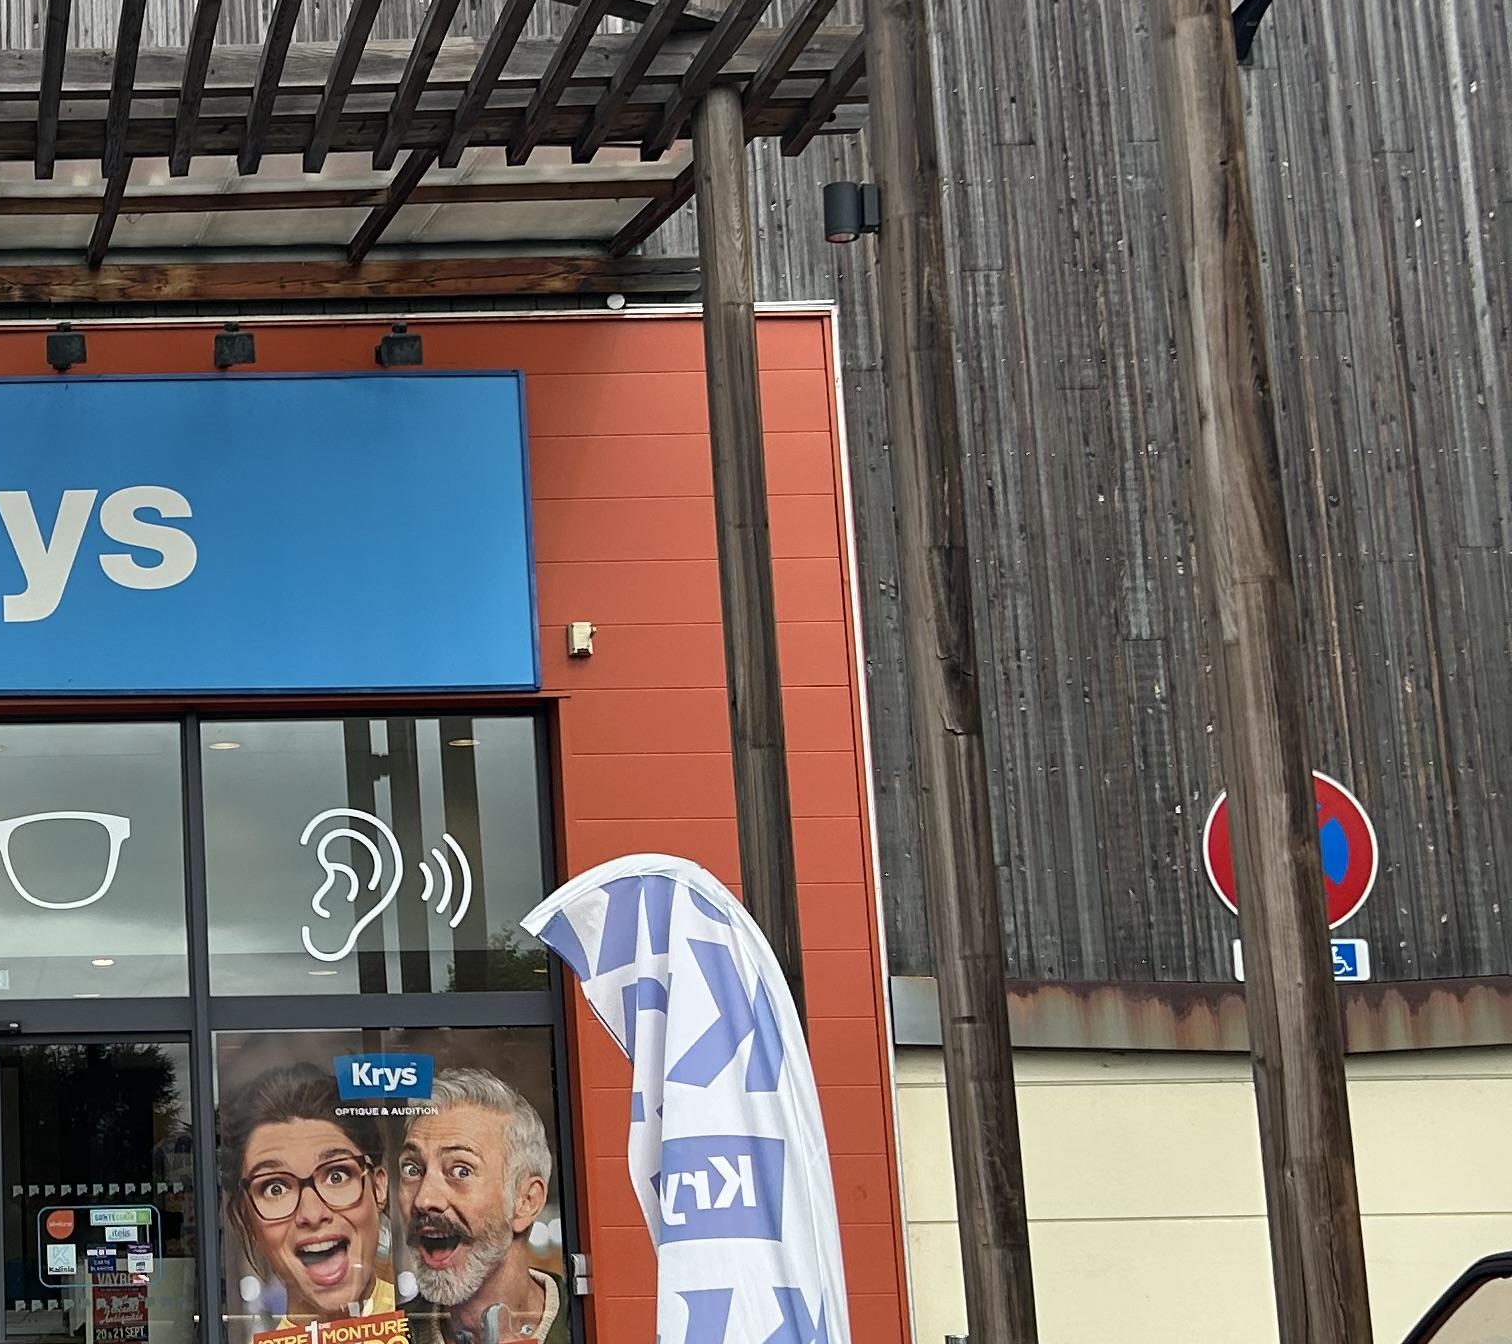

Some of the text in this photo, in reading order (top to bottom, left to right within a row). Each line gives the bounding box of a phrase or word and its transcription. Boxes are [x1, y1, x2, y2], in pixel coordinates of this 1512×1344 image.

[352, 1062, 418, 1092] Krys
[335, 1106, 439, 1116] OPTIQUE & AUDITION
[95, 1328, 107, 1340] 20
[113, 1327, 124, 1339] 21
[322, 1318, 409, 1344] MONTURE
